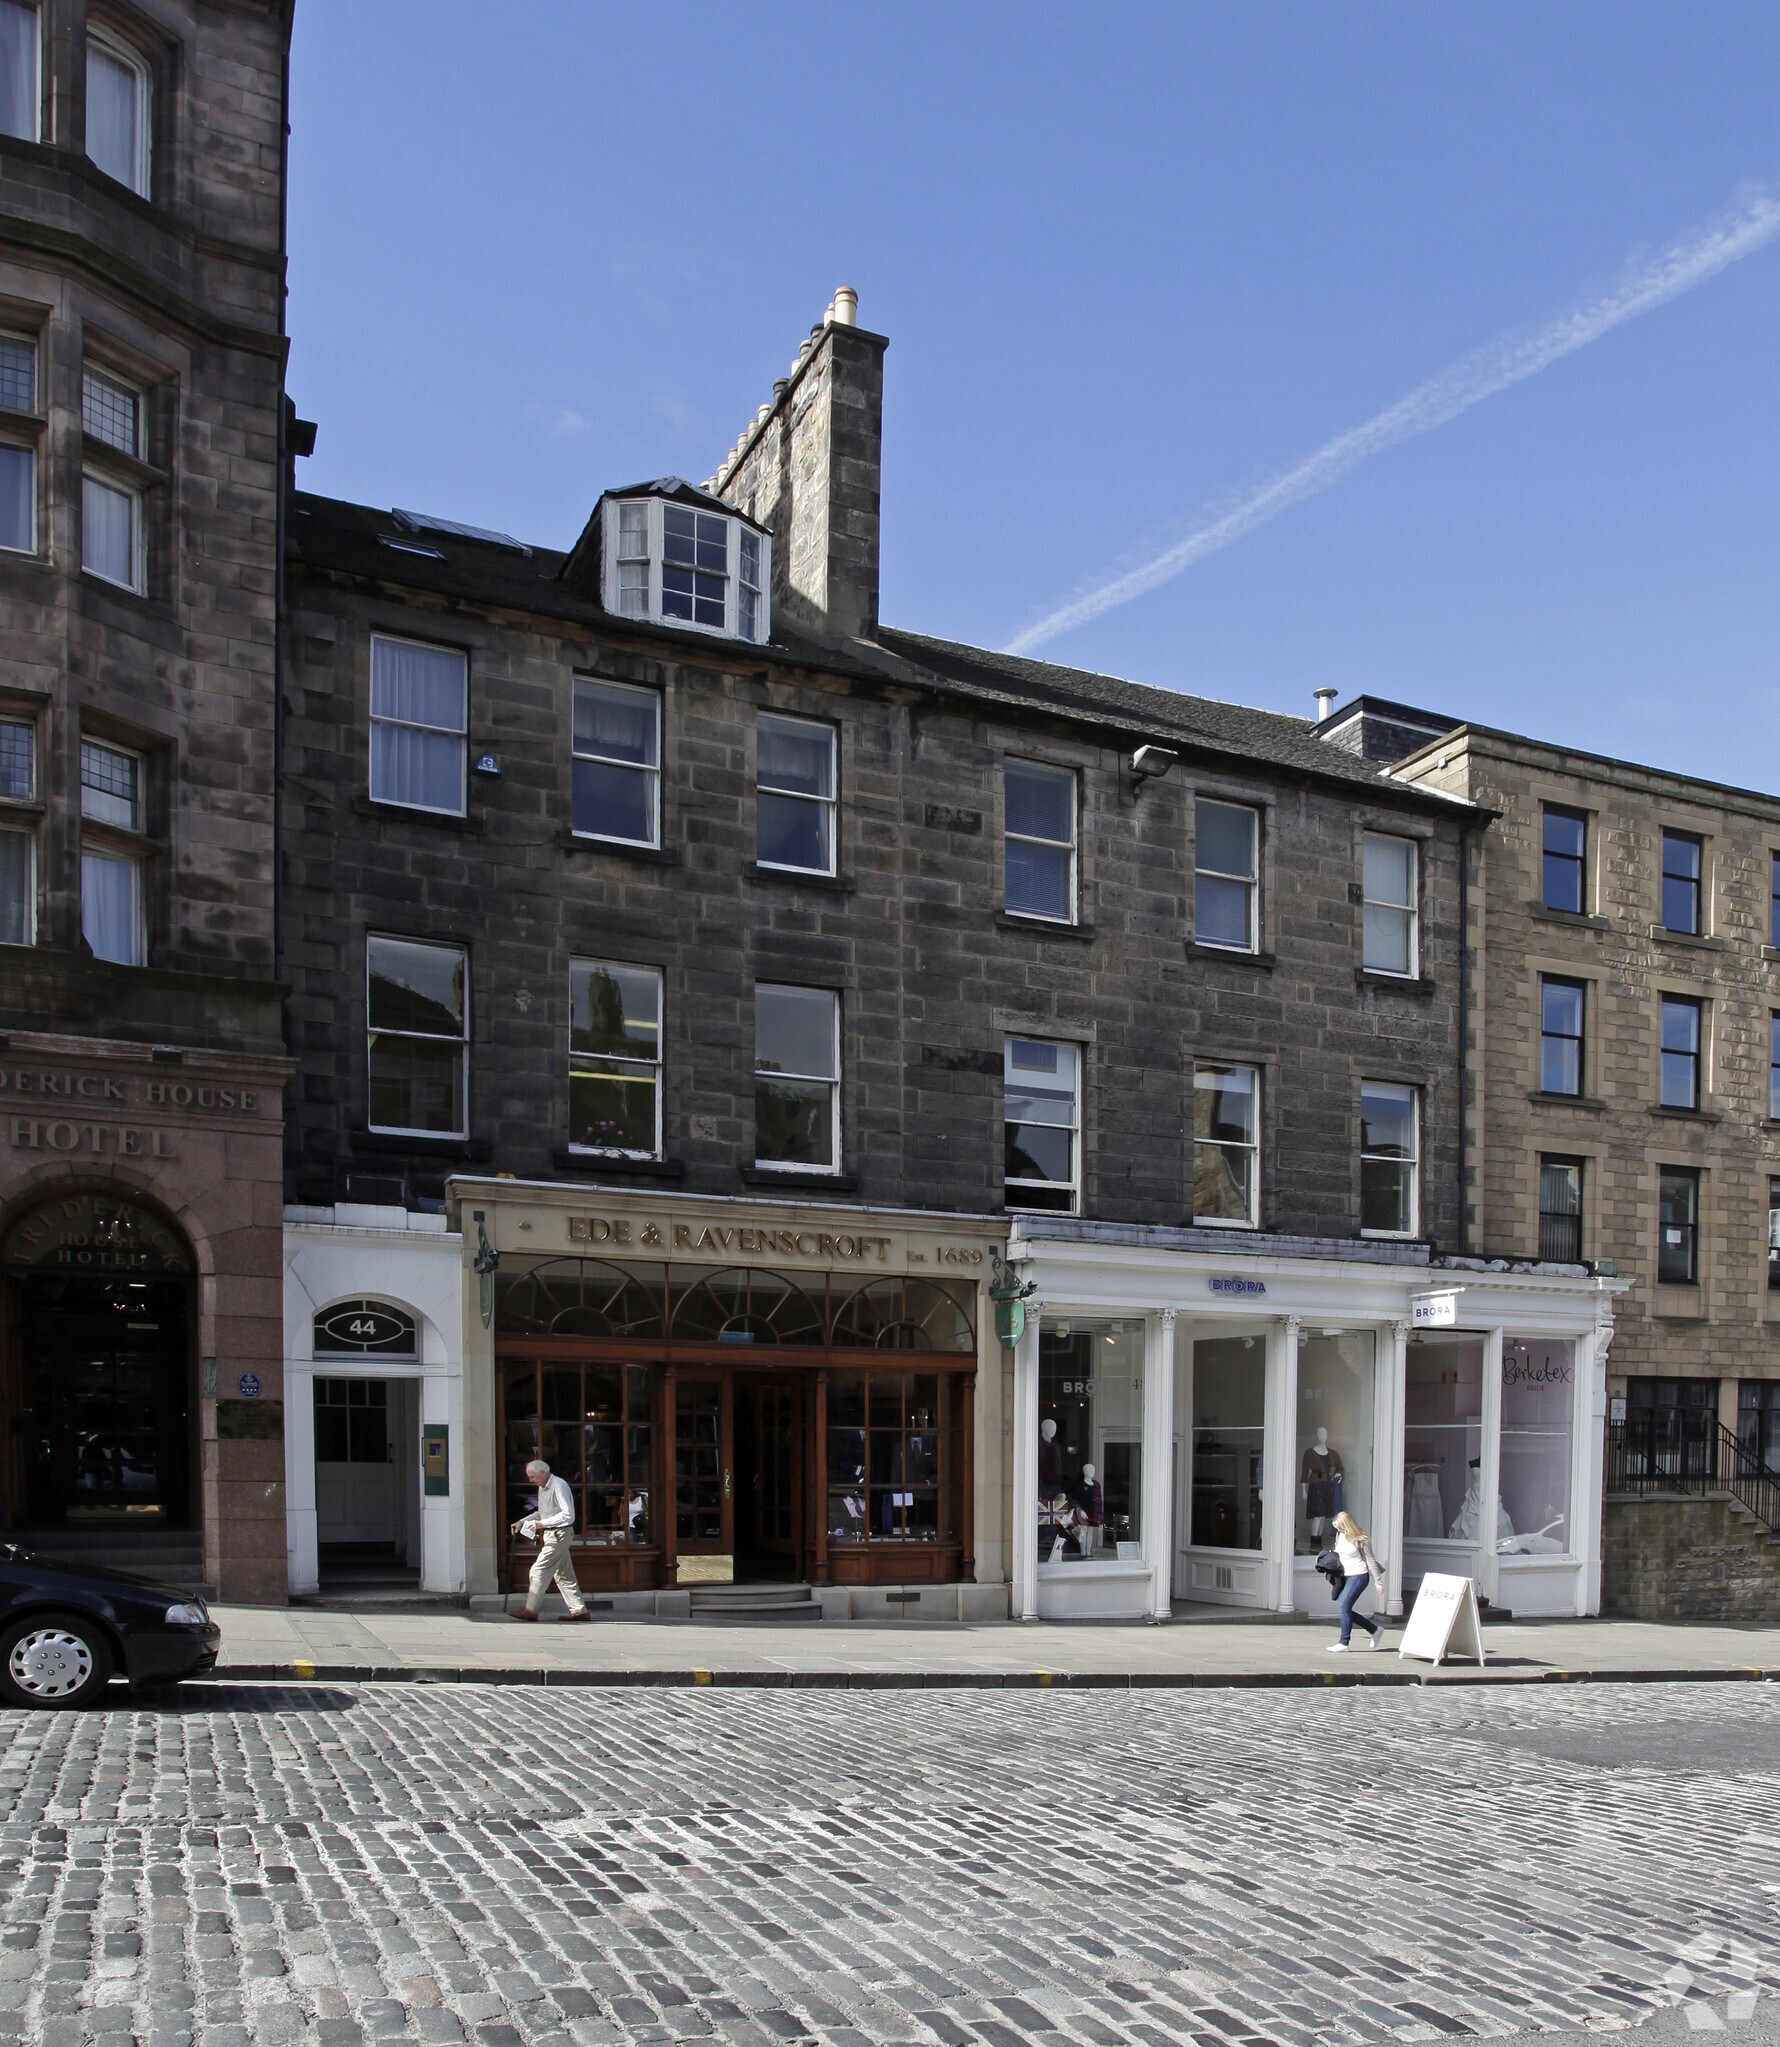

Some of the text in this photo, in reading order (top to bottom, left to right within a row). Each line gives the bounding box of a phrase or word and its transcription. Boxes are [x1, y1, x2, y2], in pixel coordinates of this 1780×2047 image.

[147, 1083, 257, 1110] HOUSE
[8, 1118, 176, 1158] HOTEL
[12, 1199, 180, 1269] FREDERICK
[59, 1231, 139, 1250] HOUSE
[568, 1216, 632, 1243] EDE
[641, 1222, 664, 1245] &
[674, 1224, 891, 1260] RAVENSCROFT
[936, 1247, 983, 1265] 1689
[57, 1250, 141, 1267] HOTEL
[1211, 1278, 1266, 1293] BRORA
[1416, 1305, 1451, 1318] BRORA
[349, 1319, 376, 1335] 44
[1502, 1354, 1573, 1386] Berketex
[1423, 1589, 1455, 1600] BRORA
